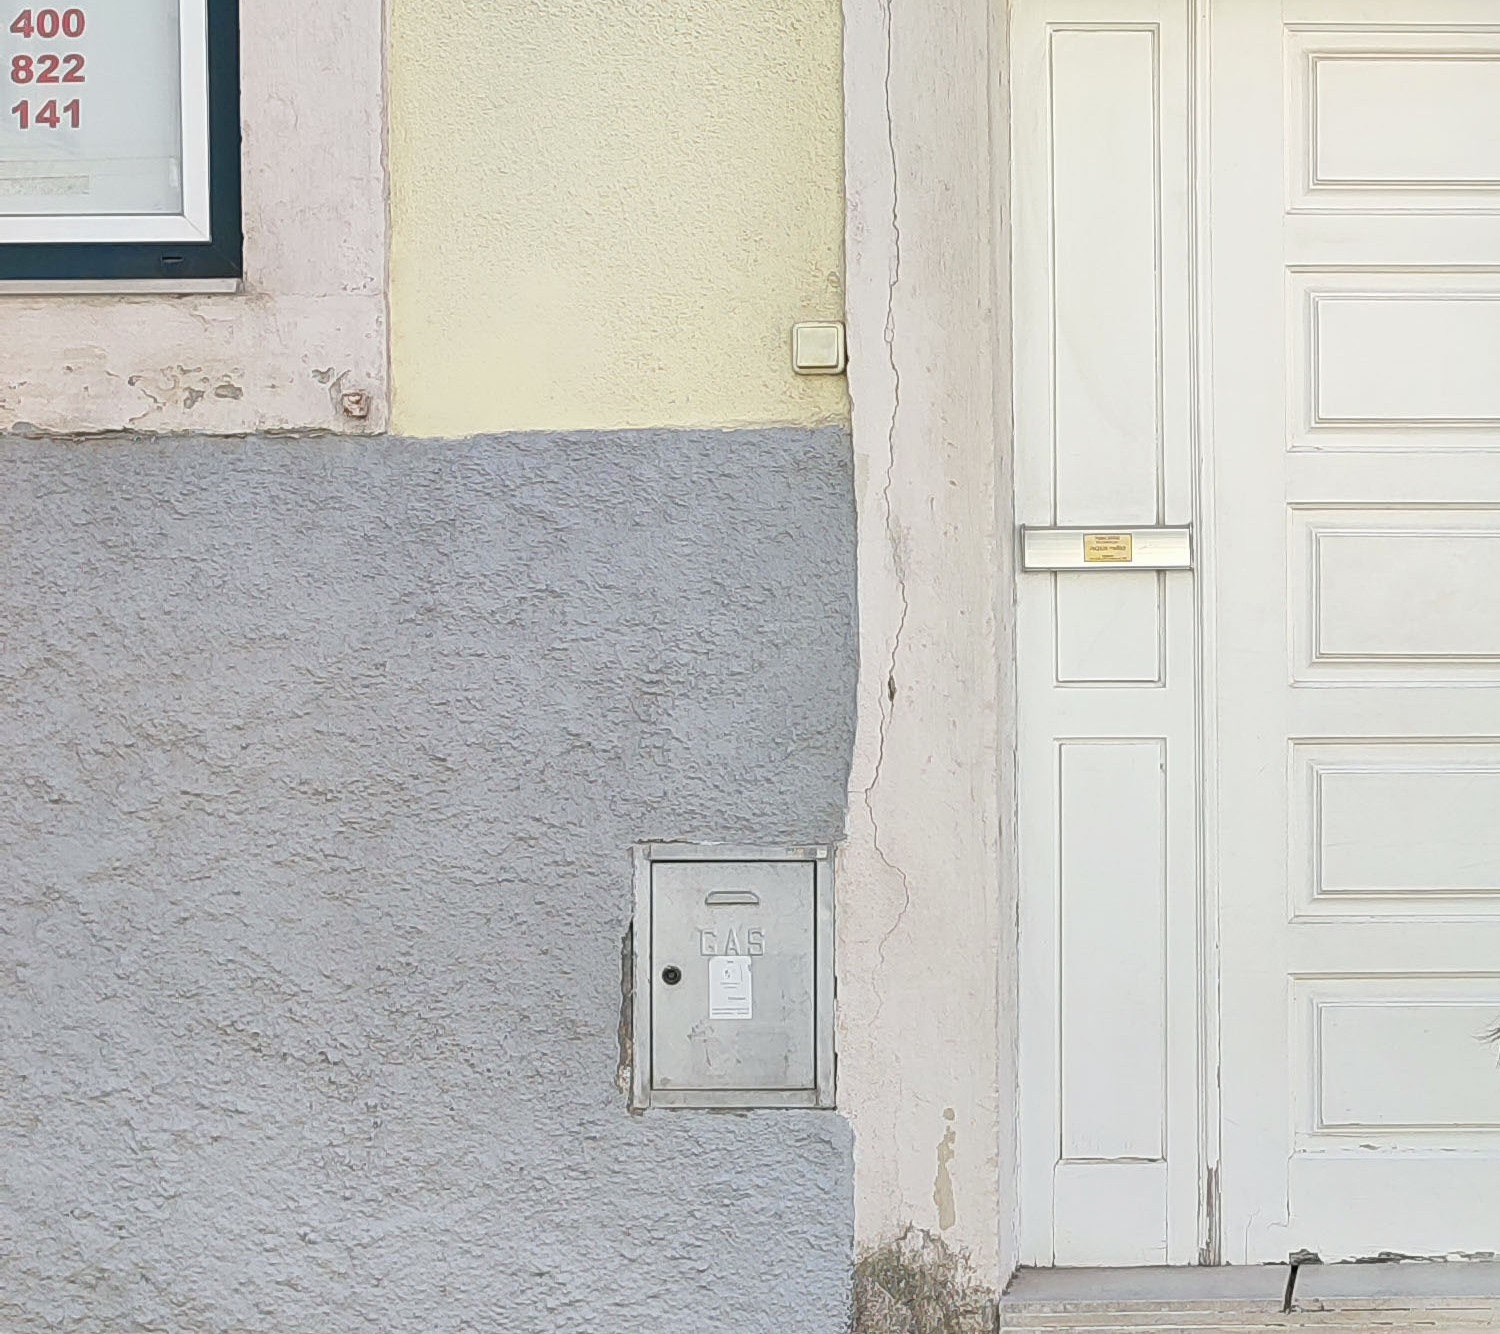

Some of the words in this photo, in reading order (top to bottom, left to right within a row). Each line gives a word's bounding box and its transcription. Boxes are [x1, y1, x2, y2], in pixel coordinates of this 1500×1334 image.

[10, 8, 86, 39] 400
[10, 53, 86, 85] 822
[11, 98, 81, 130] 141
[700, 927, 766, 956] GAS
